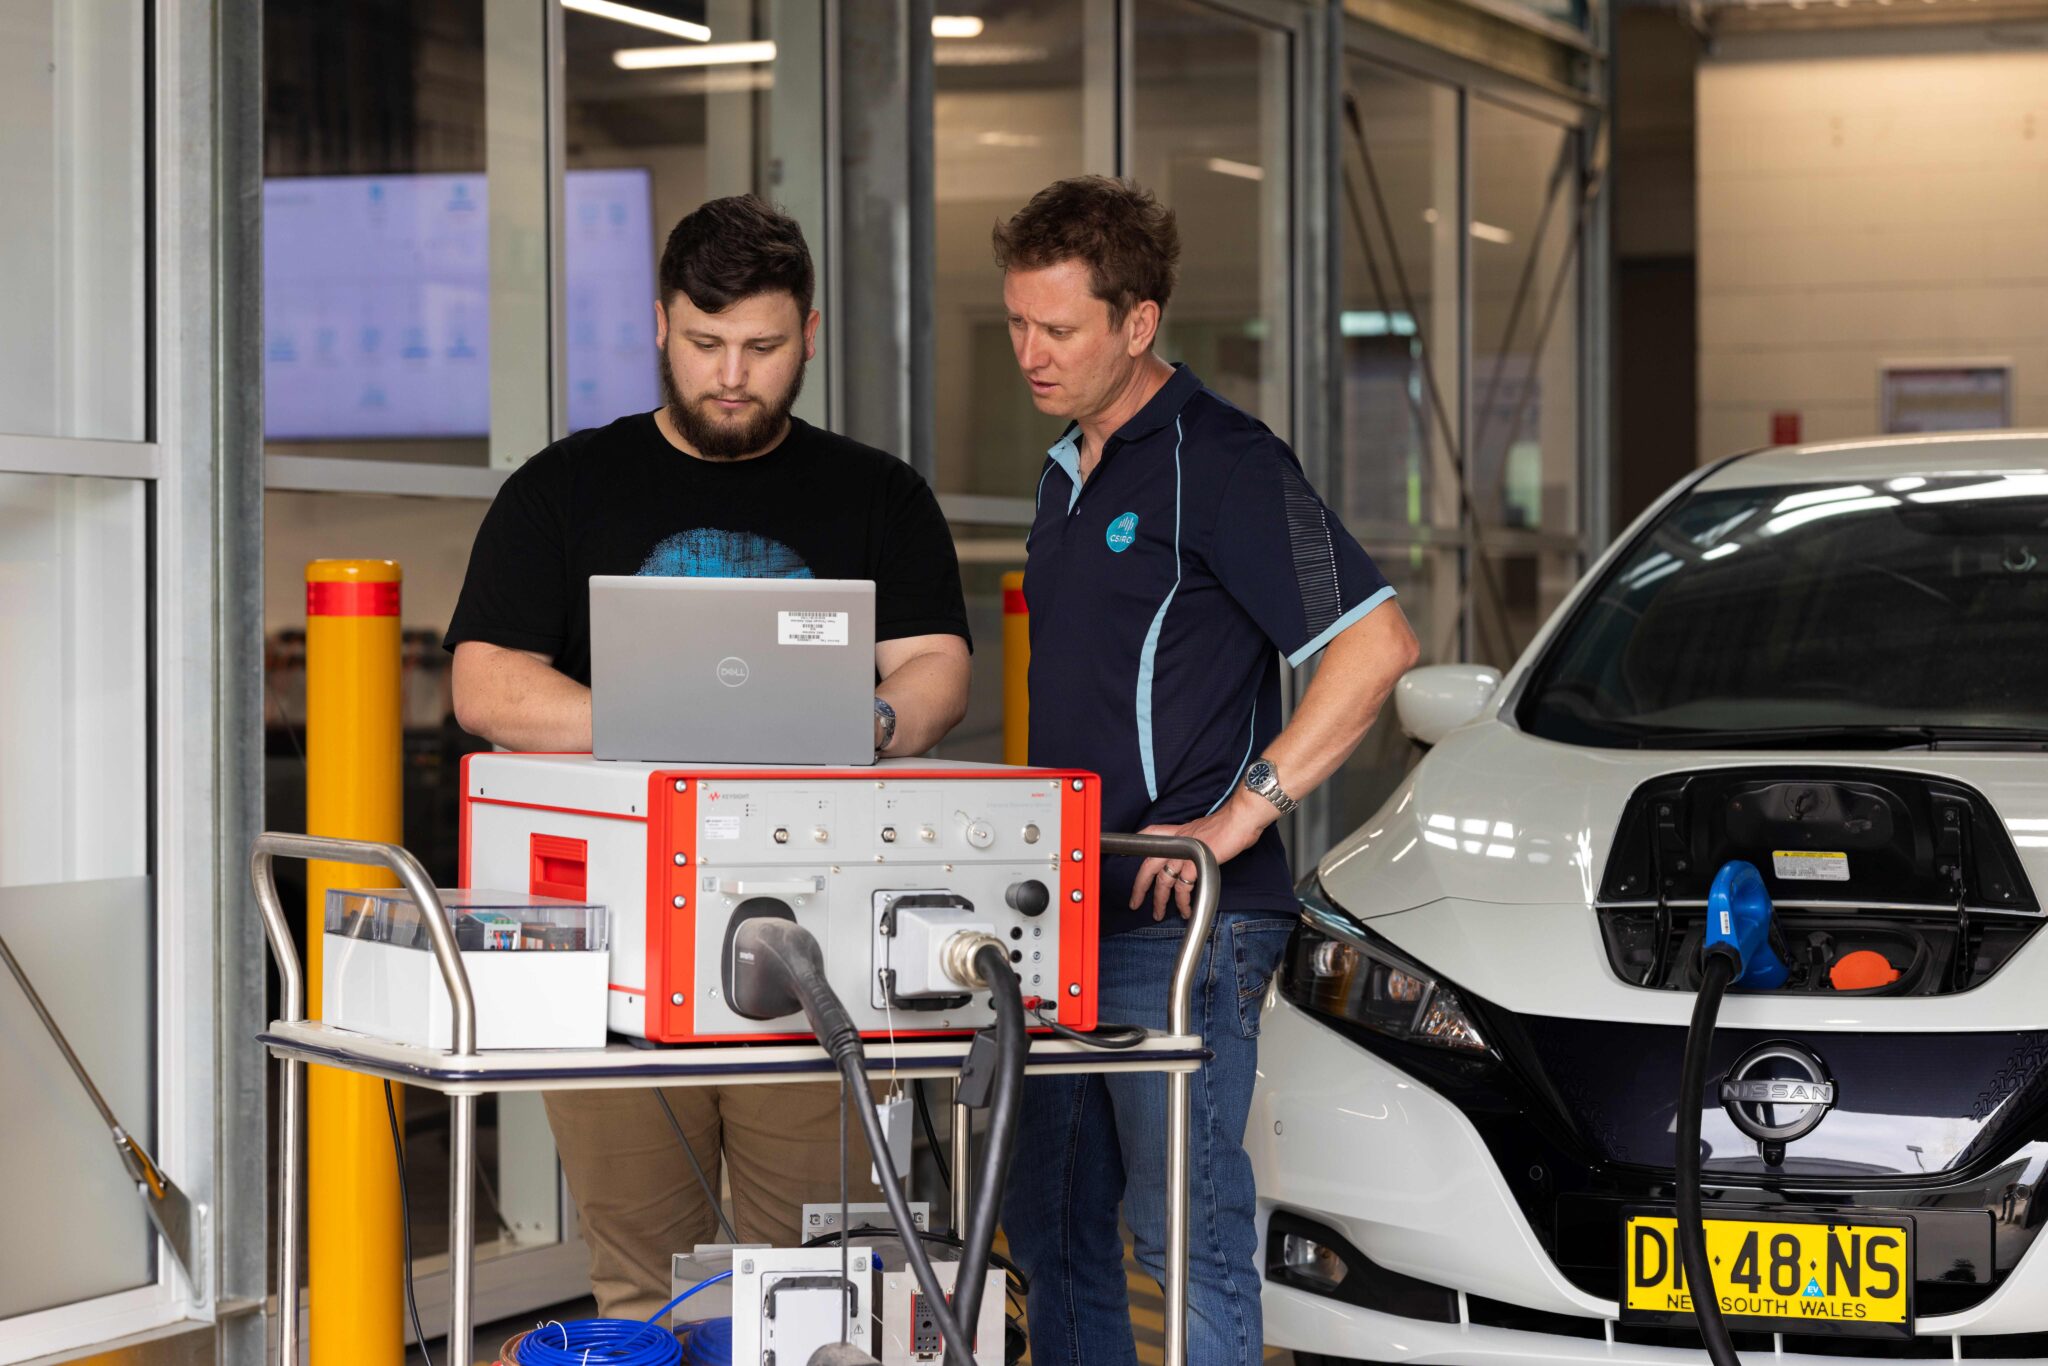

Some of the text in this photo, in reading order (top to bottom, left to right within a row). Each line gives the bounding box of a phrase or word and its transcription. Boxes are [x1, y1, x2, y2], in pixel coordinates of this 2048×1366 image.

[1110, 534, 1132, 544] CSIRO
[721, 667, 745, 677] DELL
[1723, 1083, 1831, 1101] NISSAN
[1807, 1285, 1819, 1294] EV
[1667, 1293, 1867, 1318] NE SOUTH WALES
